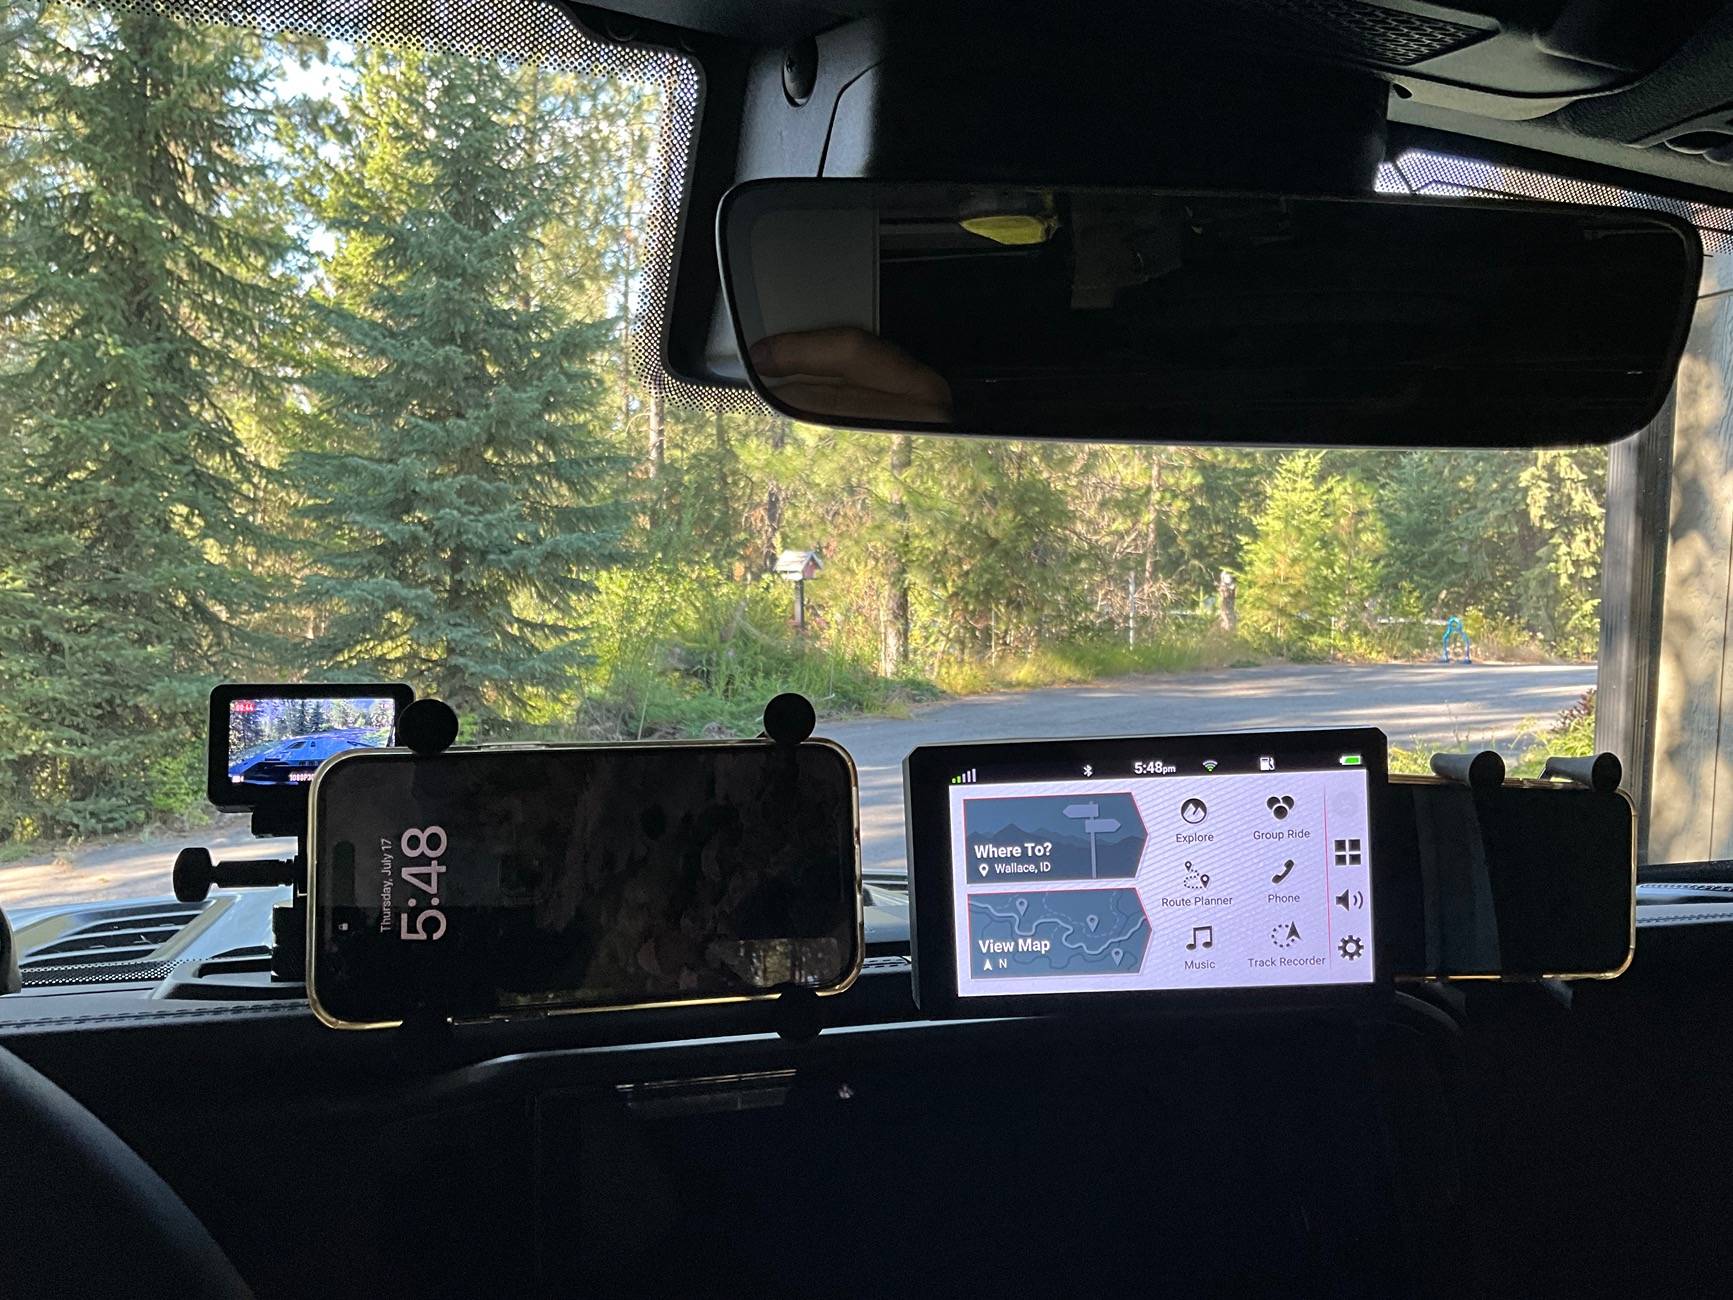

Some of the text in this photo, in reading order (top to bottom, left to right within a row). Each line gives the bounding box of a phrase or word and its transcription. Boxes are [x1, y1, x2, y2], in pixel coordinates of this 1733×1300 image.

[1134, 761, 1176, 774] 5:48pm
[1176, 832, 1214, 844] Explore
[1253, 829, 1310, 842] Group Ride
[974, 843, 1052, 858] Where To?
[995, 862, 1050, 875] Wallace, ID
[380, 838, 394, 933] Thursday, July 17
[401, 826, 447, 940] 5:48
[1162, 895, 1232, 907] Route Planner
[1268, 893, 1300, 903] Phone
[978, 939, 1050, 954] View Map
[999, 959, 1007, 968] N
[1184, 959, 1215, 969] Music
[1248, 956, 1326, 967] Track Recorder
